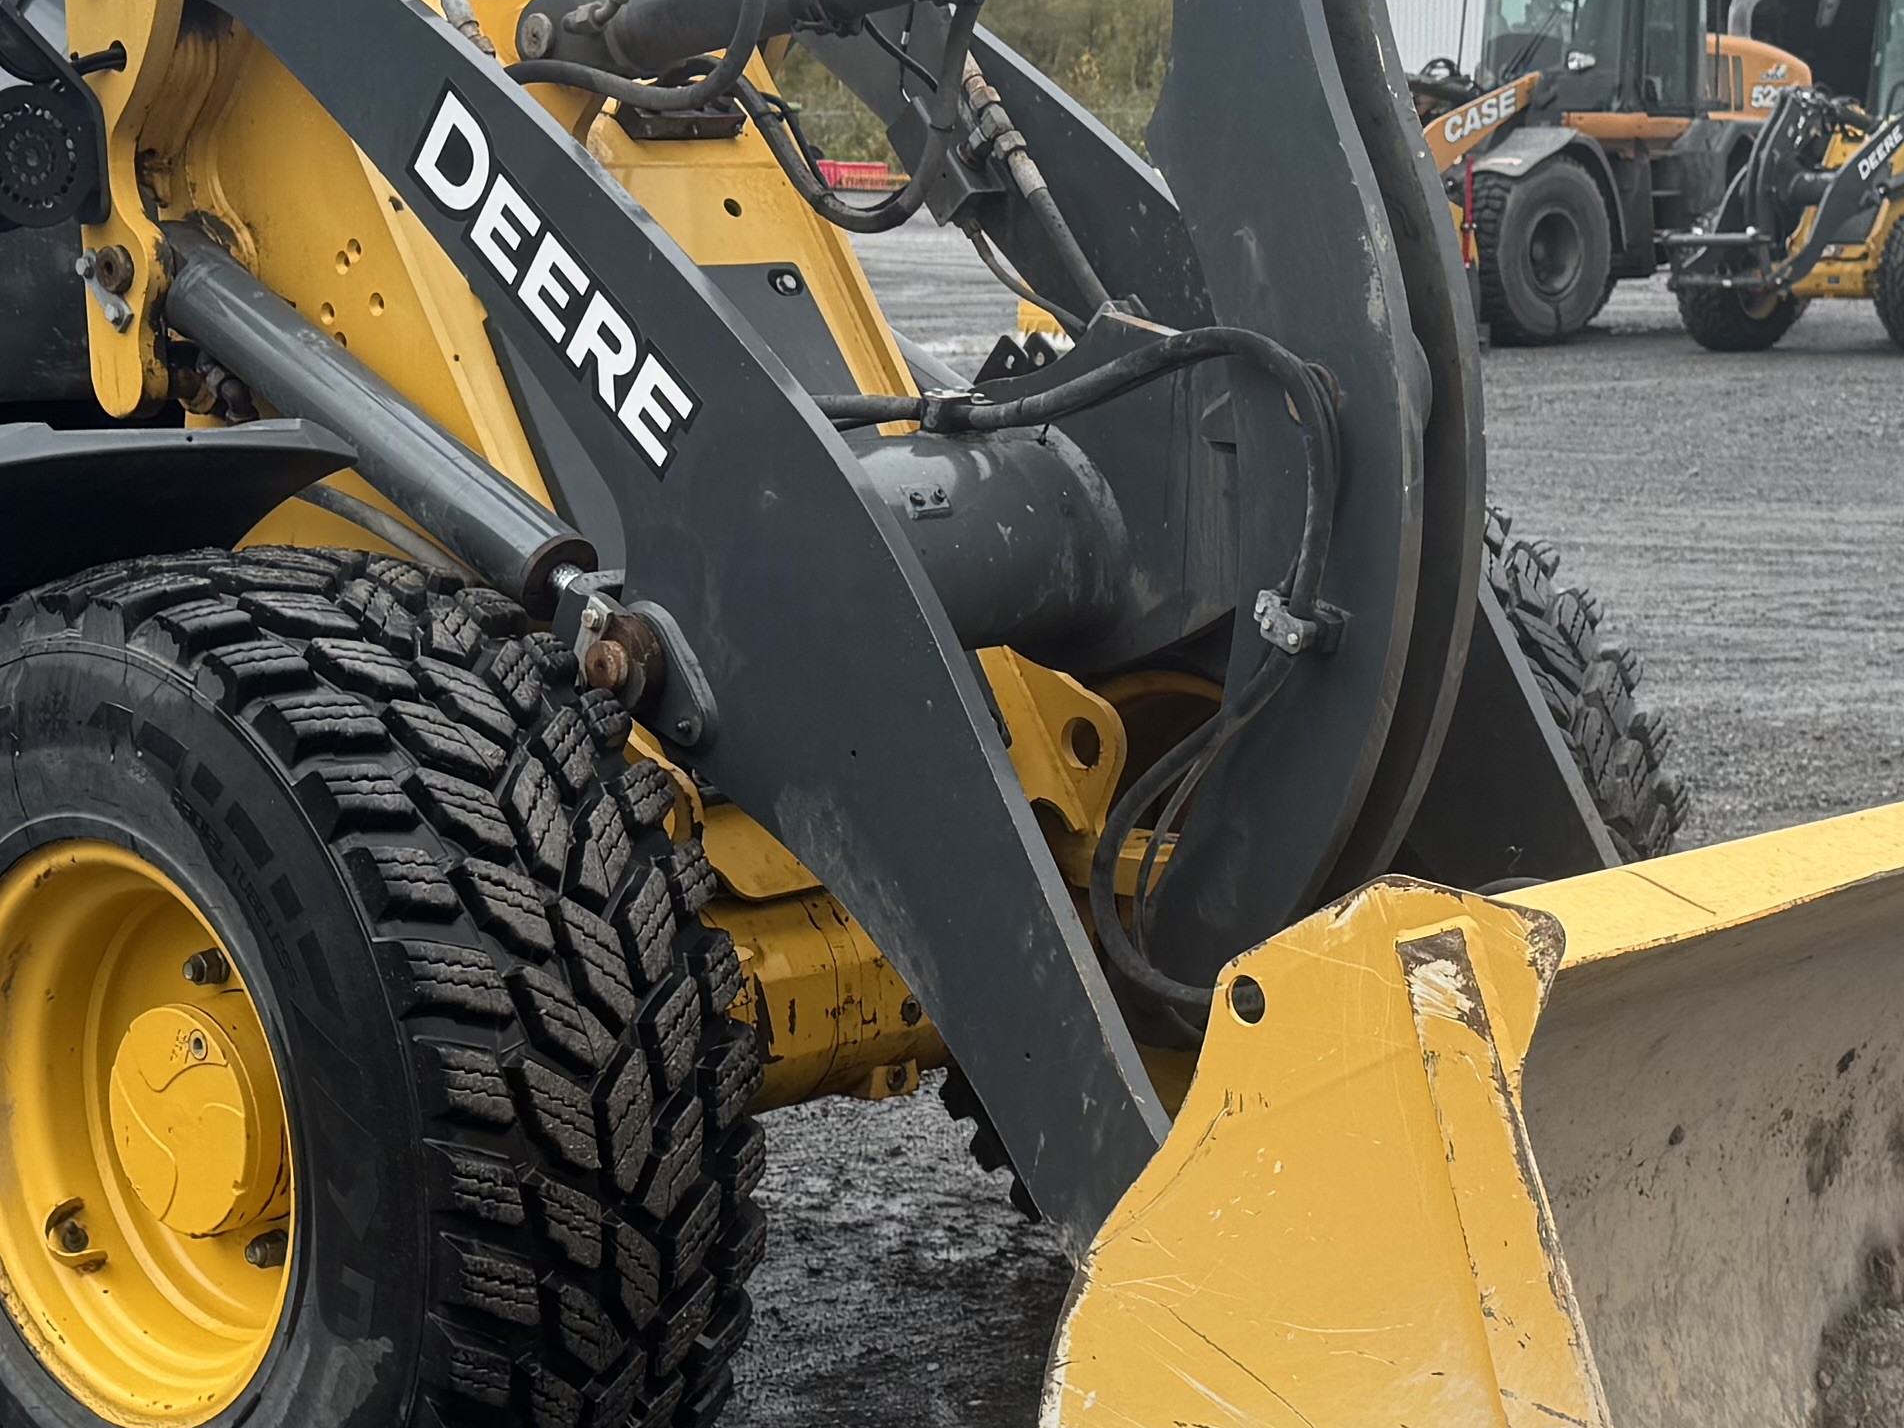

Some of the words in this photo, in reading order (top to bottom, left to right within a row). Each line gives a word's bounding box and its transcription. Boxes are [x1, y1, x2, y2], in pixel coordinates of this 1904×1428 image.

[1444, 87, 1517, 143] CASE
[1751, 84, 1785, 108] 52
[1857, 124, 1904, 181] DEERE
[414, 90, 693, 467] DEERE
